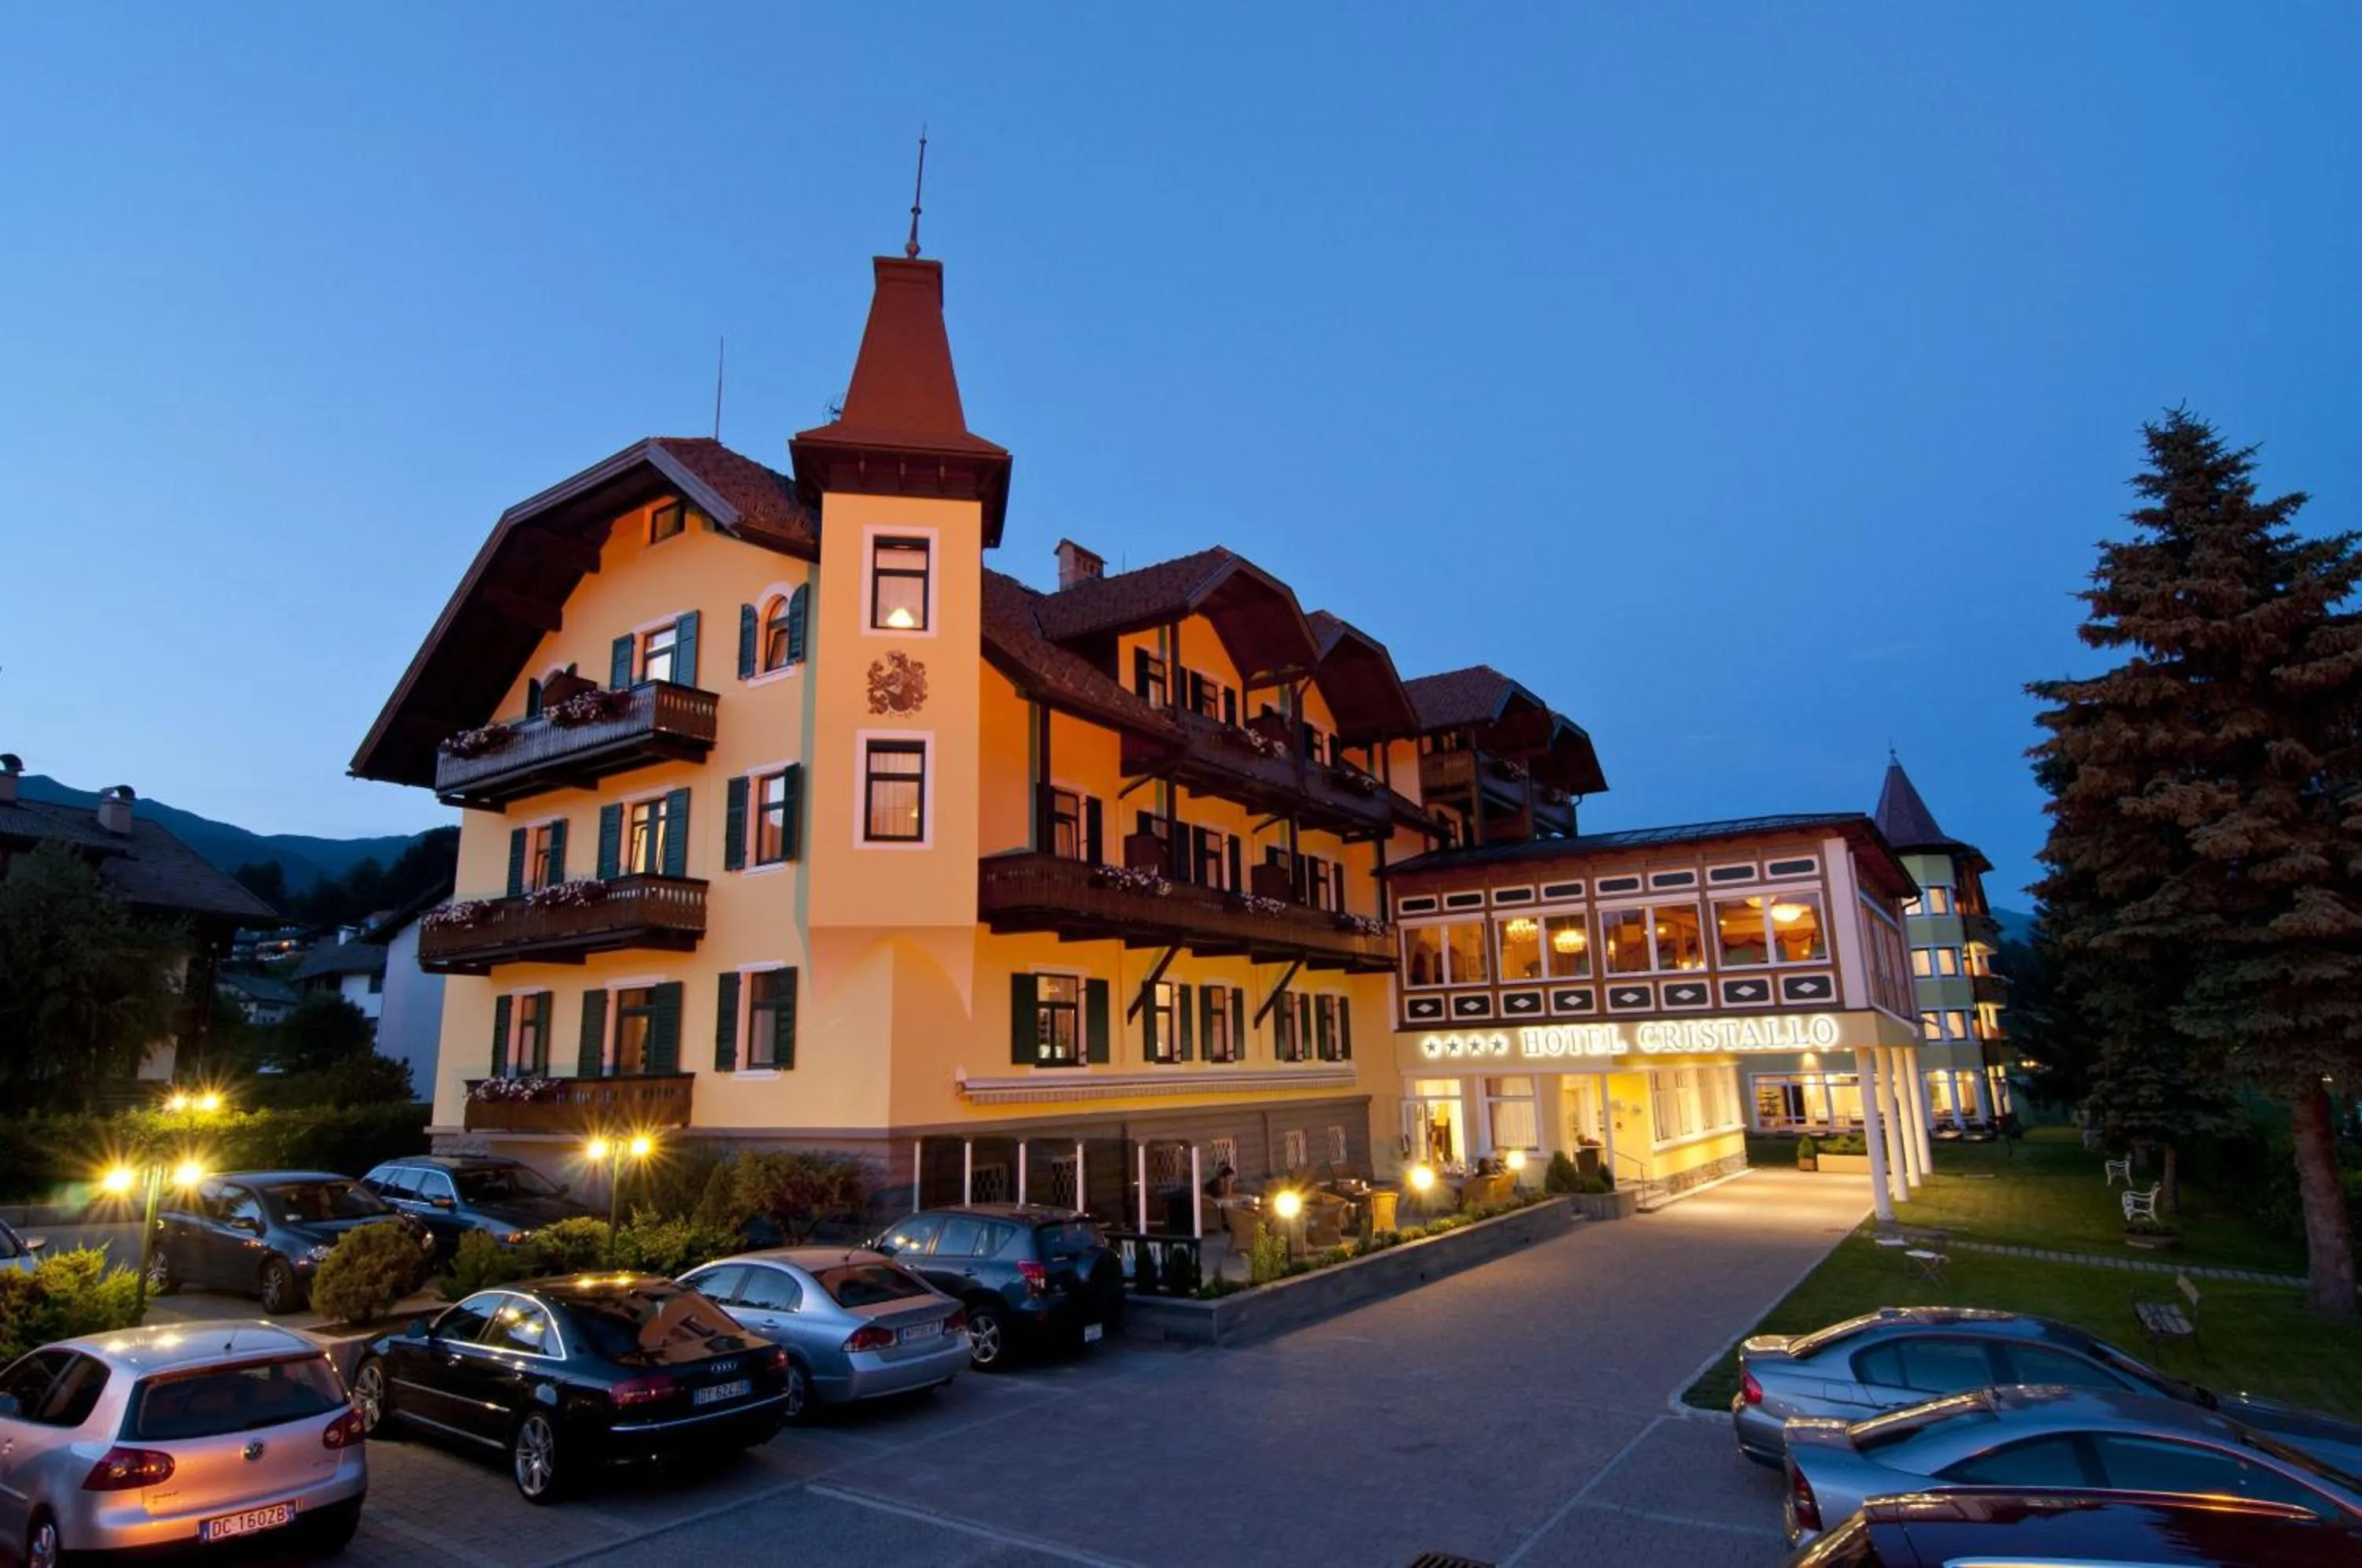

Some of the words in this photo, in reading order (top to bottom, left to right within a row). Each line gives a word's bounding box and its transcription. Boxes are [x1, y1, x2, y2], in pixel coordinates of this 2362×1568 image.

[1522, 1026, 1627, 1055] HOTEL
[1639, 1017, 1835, 1051] CRISTALLO
[212, 1518, 232, 1537] DC
